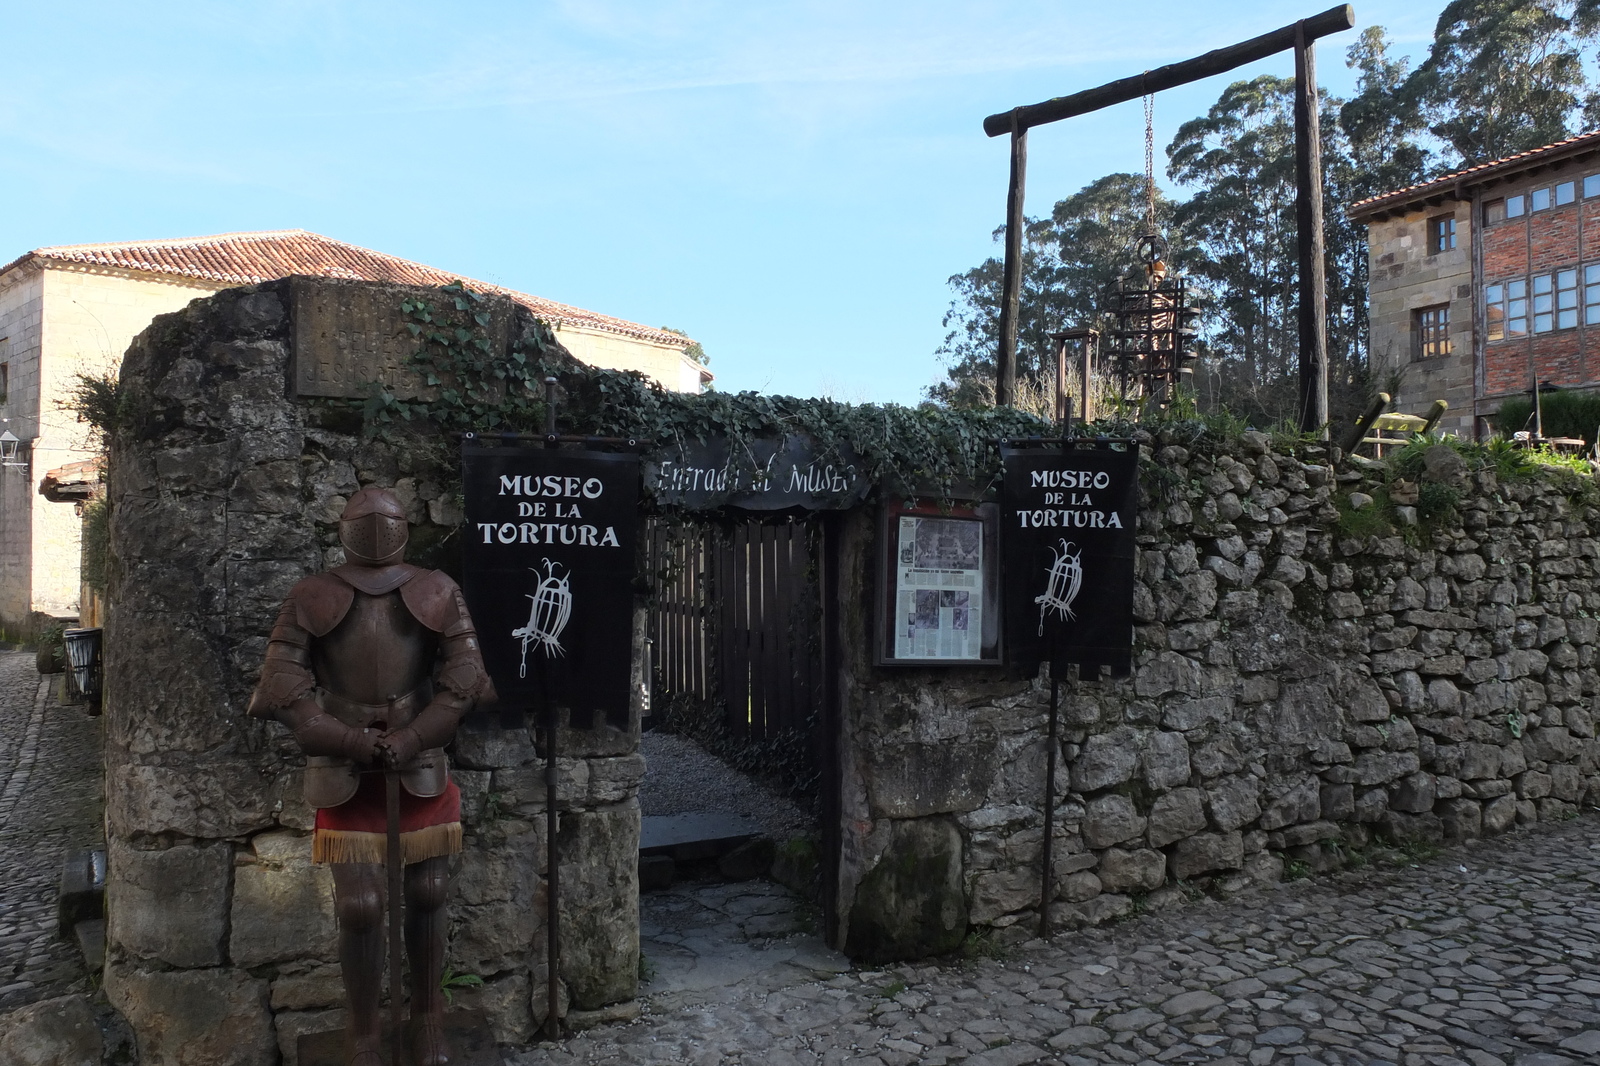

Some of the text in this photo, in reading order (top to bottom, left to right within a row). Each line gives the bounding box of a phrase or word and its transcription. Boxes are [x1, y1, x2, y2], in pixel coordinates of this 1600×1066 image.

[306, 361, 369, 384] JESUS
[498, 474, 603, 499] MUSEO
[1030, 470, 1110, 490] MUSEO
[1044, 492, 1093, 506] DE LA
[518, 502, 582, 519] DE LA
[1016, 509, 1123, 529] TORTURA
[477, 522, 620, 547] TORTURA
